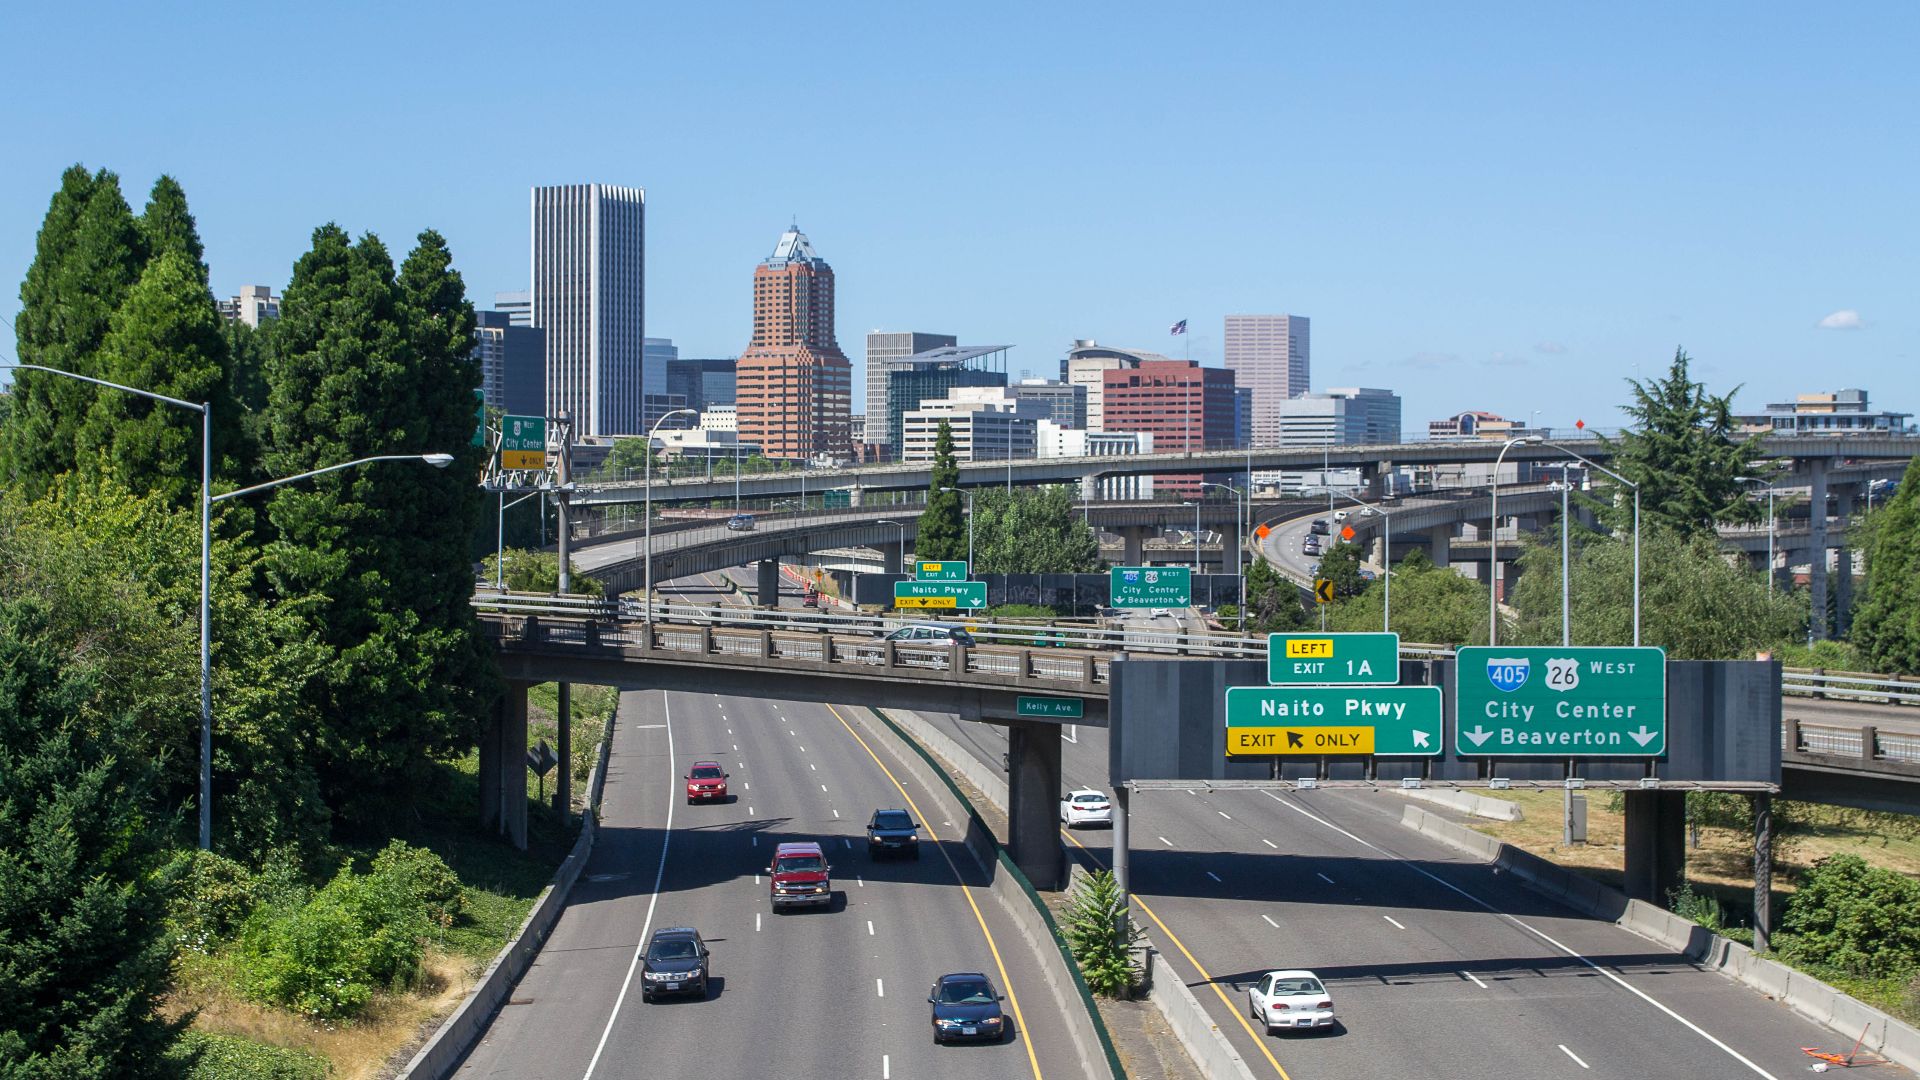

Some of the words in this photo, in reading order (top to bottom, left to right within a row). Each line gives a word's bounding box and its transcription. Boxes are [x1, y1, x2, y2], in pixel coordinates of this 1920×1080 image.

[506, 438, 519, 450] City
[522, 438, 542, 448] Center
[1146, 574, 1158, 582] 26
[944, 586, 968, 595] Pkwy
[1122, 586, 1141, 594] City
[1292, 644, 1328, 654] LEFT
[1294, 662, 1324, 674] EXIT
[1346, 660, 1373, 676] 1A
[1492, 666, 1526, 683] 405
[1551, 666, 1575, 684] 26
[1590, 661, 1636, 674] WEST
[1026, 702, 1048, 712] Kelly
[1056, 704, 1073, 712] Ave.
[1261, 700, 1324, 716] Naito
[1345, 700, 1406, 720] Pkwy
[1485, 701, 1535, 722] City
[1556, 701, 1636, 718] Center
[1240, 734, 1276, 746] EXIT
[1315, 734, 1360, 746] ONLY
[1500, 728, 1621, 745] Beaverton
